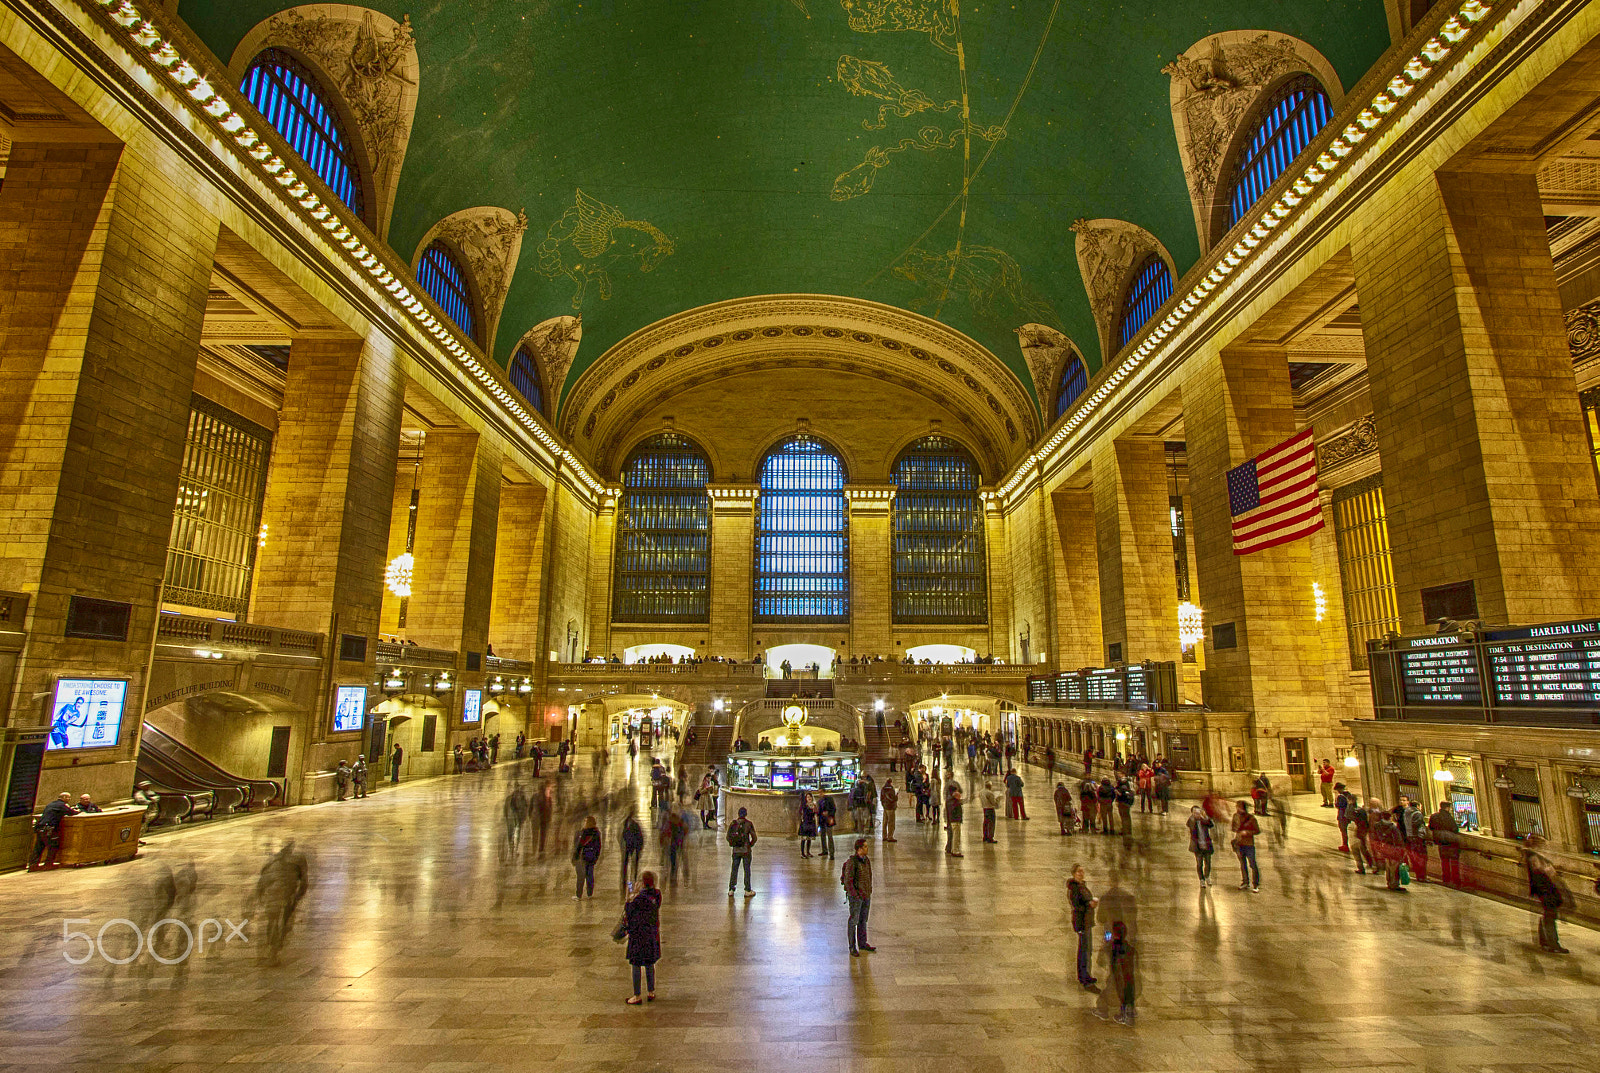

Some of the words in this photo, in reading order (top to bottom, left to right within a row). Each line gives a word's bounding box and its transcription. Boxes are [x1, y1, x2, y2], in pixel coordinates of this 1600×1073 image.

[1530, 625, 1570, 637] HARLEM
[1571, 623, 1596, 633] LINE
[1411, 636, 1459, 647] INFORMATION
[1488, 646, 1505, 654] TIME
[1507, 645, 1522, 653] TRK
[1525, 641, 1574, 652] DESTINATION
[1528, 653, 1558, 661] SOUTHEAST
[1539, 663, 1557, 671] WHITE
[1557, 662, 1580, 670] PLAINS
[1531, 673, 1561, 681] SOUTHEAST
[93, 682, 113, 690] CHOOSE
[254, 681, 270, 691] 45TH
[269, 683, 292, 697] STREET
[1561, 682, 1584, 690] PLAINS
[146, 695, 162, 709] THE
[164, 684, 198, 701] METLIFE
[199, 680, 233, 692] BUILDING
